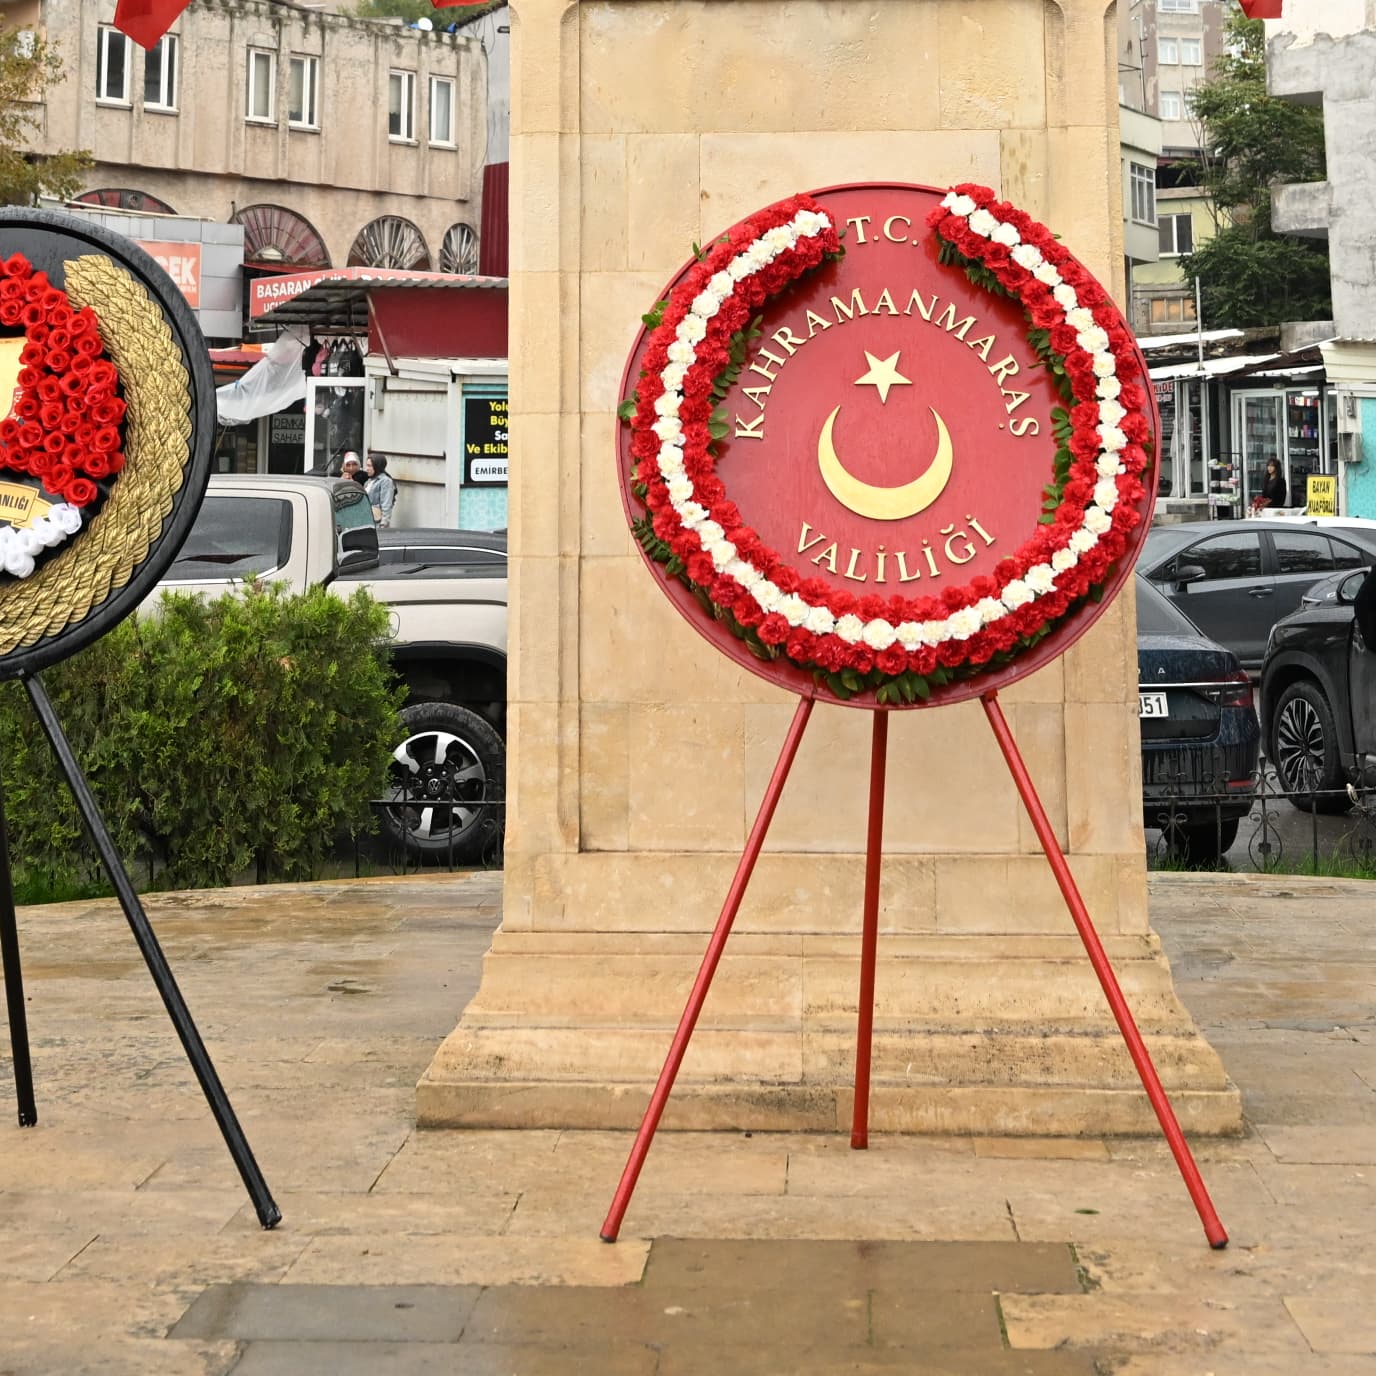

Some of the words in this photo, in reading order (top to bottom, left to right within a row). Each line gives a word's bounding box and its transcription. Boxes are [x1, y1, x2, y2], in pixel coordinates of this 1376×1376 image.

[846, 215, 919, 248] T.C.
[256, 279, 312, 299] BAŞARAN
[734, 287, 1040, 441] KAHRAMANMARAŞ
[466, 443, 481, 454] Ve
[1312, 480, 1330, 493] BAYAN
[793, 512, 998, 584] VALİLİĞİ
